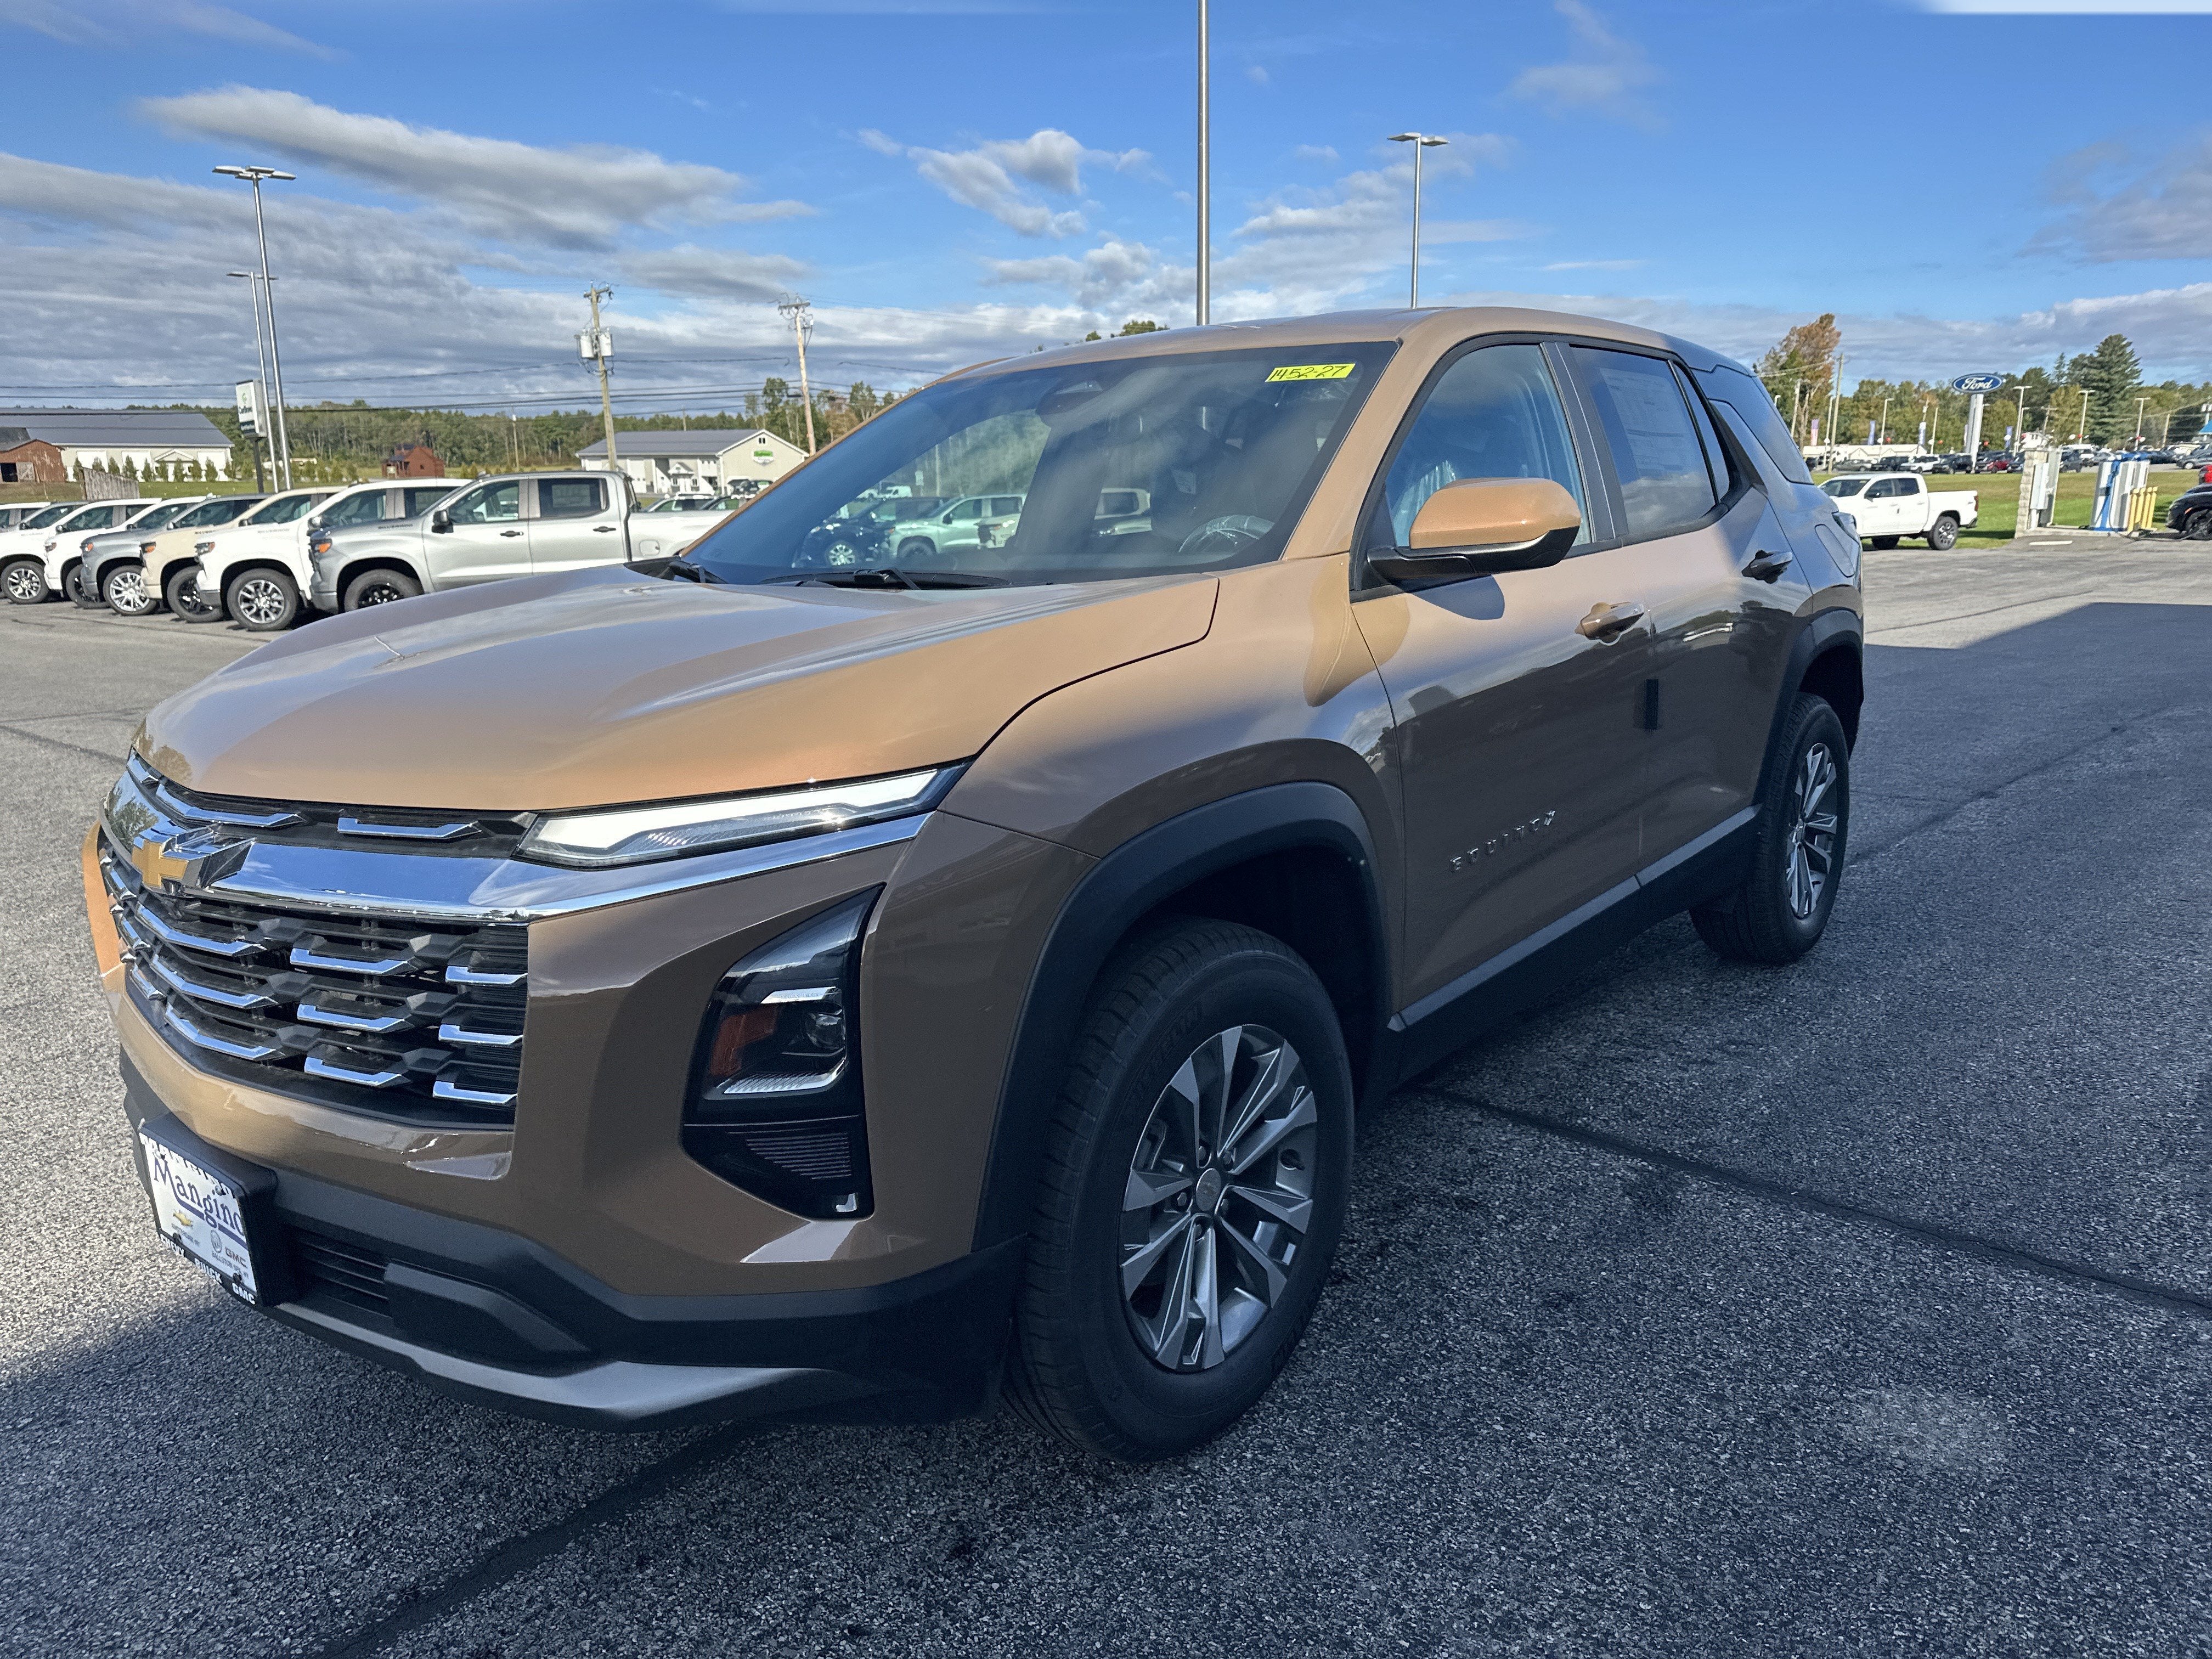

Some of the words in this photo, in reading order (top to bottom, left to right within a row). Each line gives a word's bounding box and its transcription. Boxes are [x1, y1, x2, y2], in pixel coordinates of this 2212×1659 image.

[1961, 377, 1994, 390] Ford
[1449, 810, 1556, 872] EQUINOX
[160, 1233, 185, 1257] CHEVY
[224, 1246, 248, 1269] GMC
[194, 1257, 223, 1284] BUICK
[232, 1282, 256, 1305] GMC
